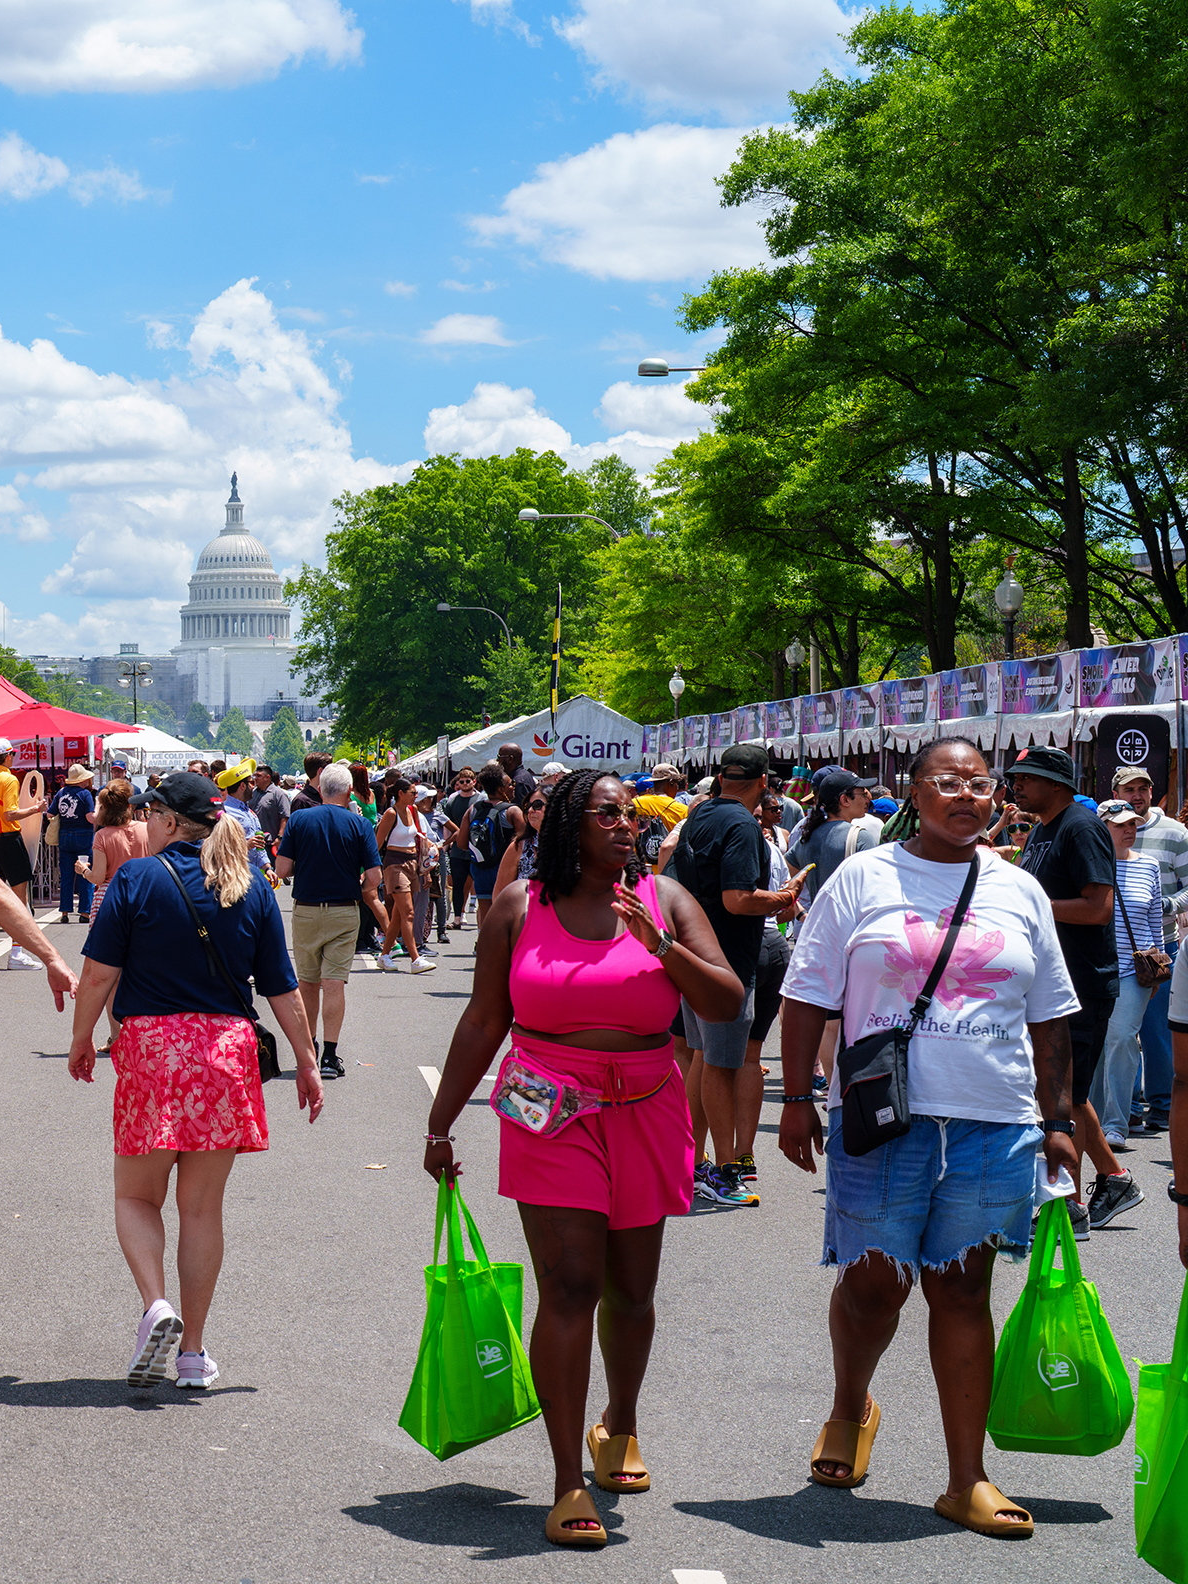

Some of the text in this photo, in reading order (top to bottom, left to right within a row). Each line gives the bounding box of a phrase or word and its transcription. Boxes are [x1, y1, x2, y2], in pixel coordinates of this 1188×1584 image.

[562, 734, 631, 760] Giant
[148, 759, 187, 767] AVAILABLE
[920, 1016, 951, 1033] the
